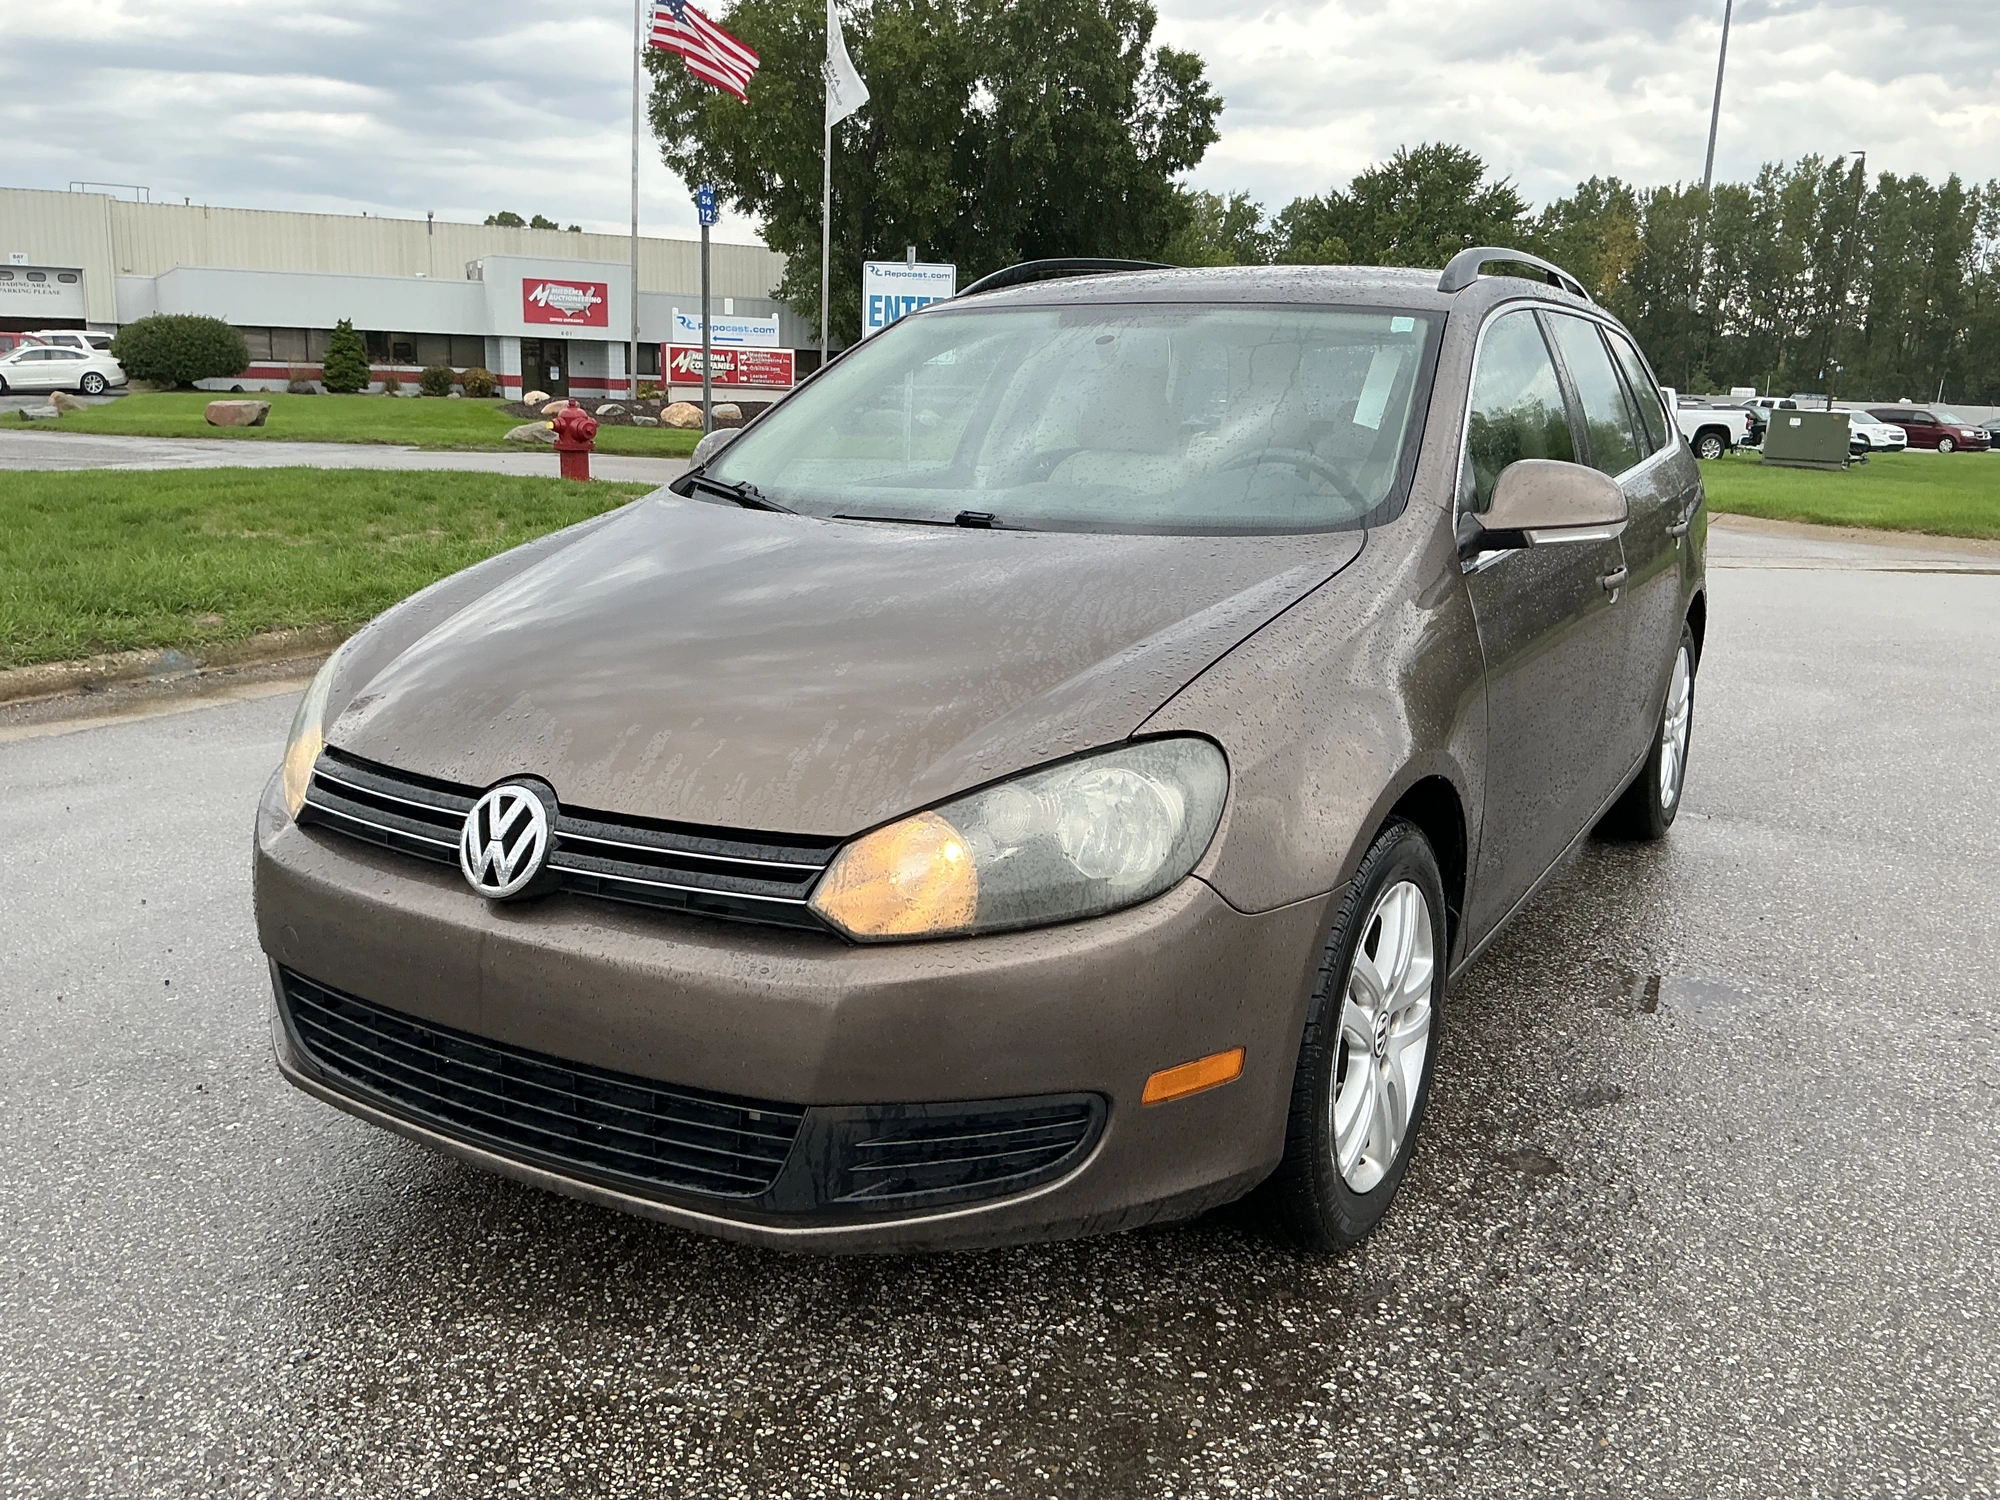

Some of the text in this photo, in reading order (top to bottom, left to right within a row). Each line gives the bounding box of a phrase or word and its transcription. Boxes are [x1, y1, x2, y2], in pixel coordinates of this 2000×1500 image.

[701, 196, 711, 205] 56
[700, 209, 712, 221] 12
[884, 270, 951, 279] Repocast.com
[551, 288, 583, 296] MIEDEMA
[548, 295, 602, 303] AUCTIONEERING
[869, 295, 945, 327] ENT
[698, 322, 775, 334] Rpocast.com
[692, 353, 726, 362] MIEEMA
[691, 361, 735, 370] COANIES
